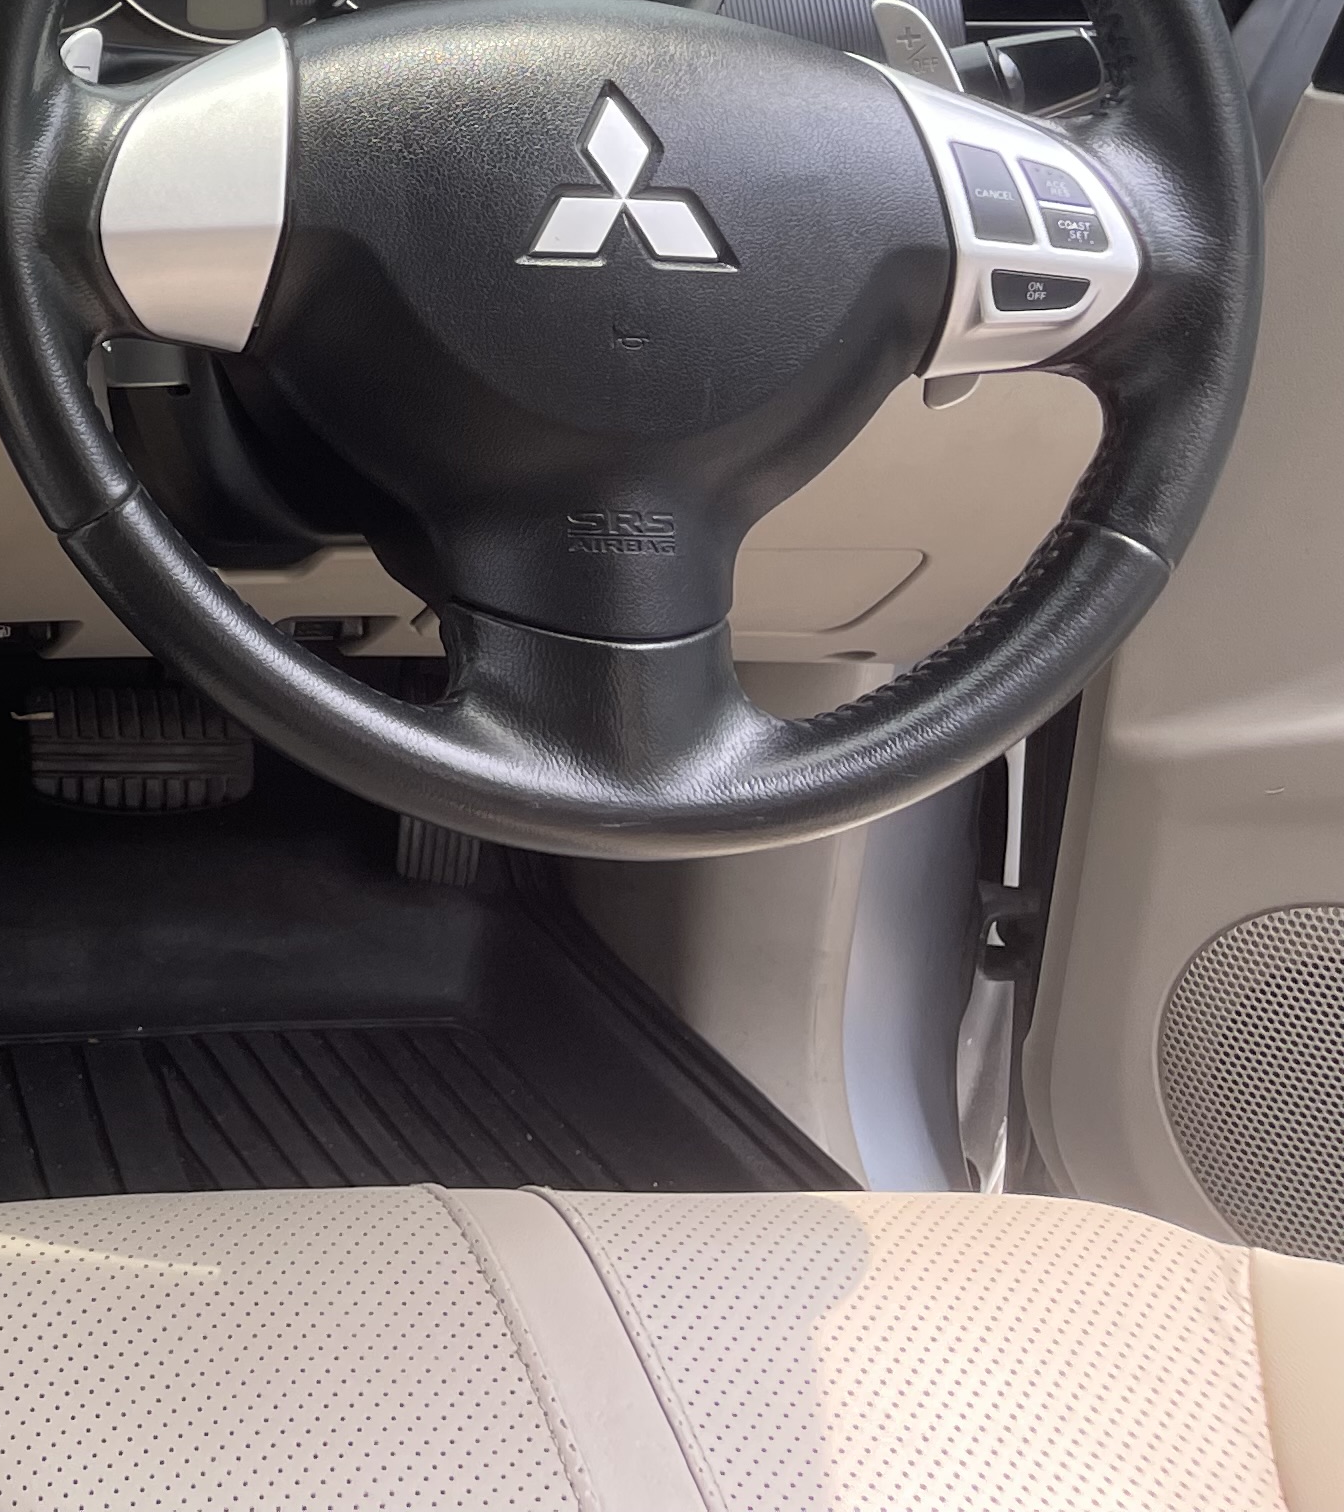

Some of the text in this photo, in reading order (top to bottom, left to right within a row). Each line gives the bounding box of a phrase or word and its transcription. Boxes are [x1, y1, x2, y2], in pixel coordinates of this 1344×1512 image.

[975, 188, 1014, 201] CANCEL
[1058, 220, 1091, 231] COAST
[1069, 231, 1089, 239] SET
[1028, 281, 1044, 291] ON
[1026, 291, 1046, 301] OFF
[567, 511, 675, 536] SRS
[568, 539, 675, 556] AIRBAG
